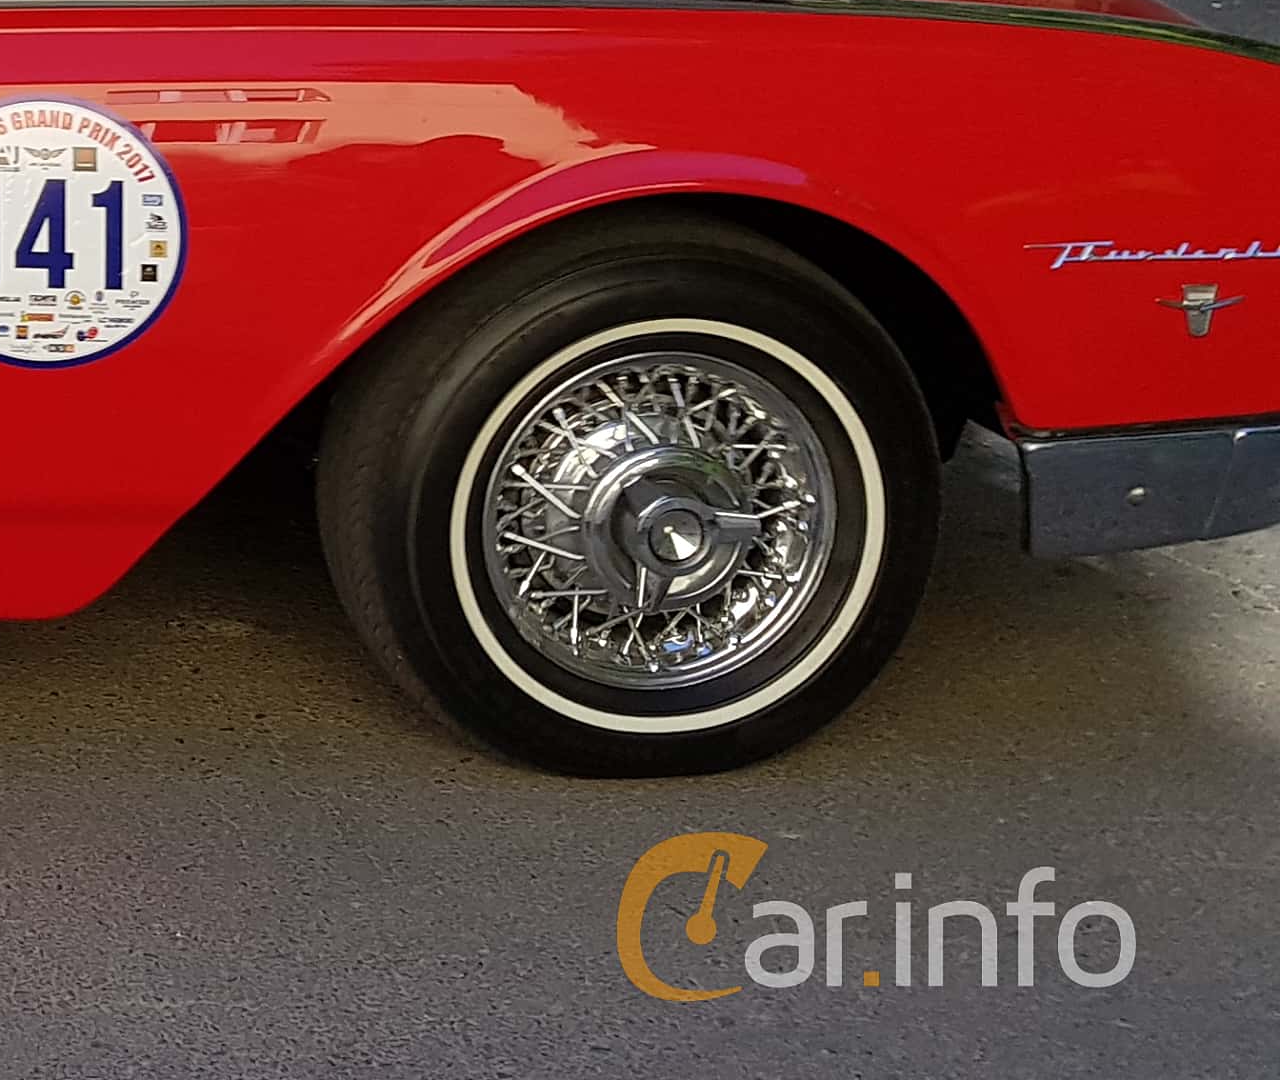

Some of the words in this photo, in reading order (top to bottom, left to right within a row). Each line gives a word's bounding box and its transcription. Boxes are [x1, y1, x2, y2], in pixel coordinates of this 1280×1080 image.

[12, 109, 73, 131] GRAND
[77, 116, 122, 152] PRIX
[115, 142, 156, 183] 2017
[1023, 240, 1280, 270] Thunderb
